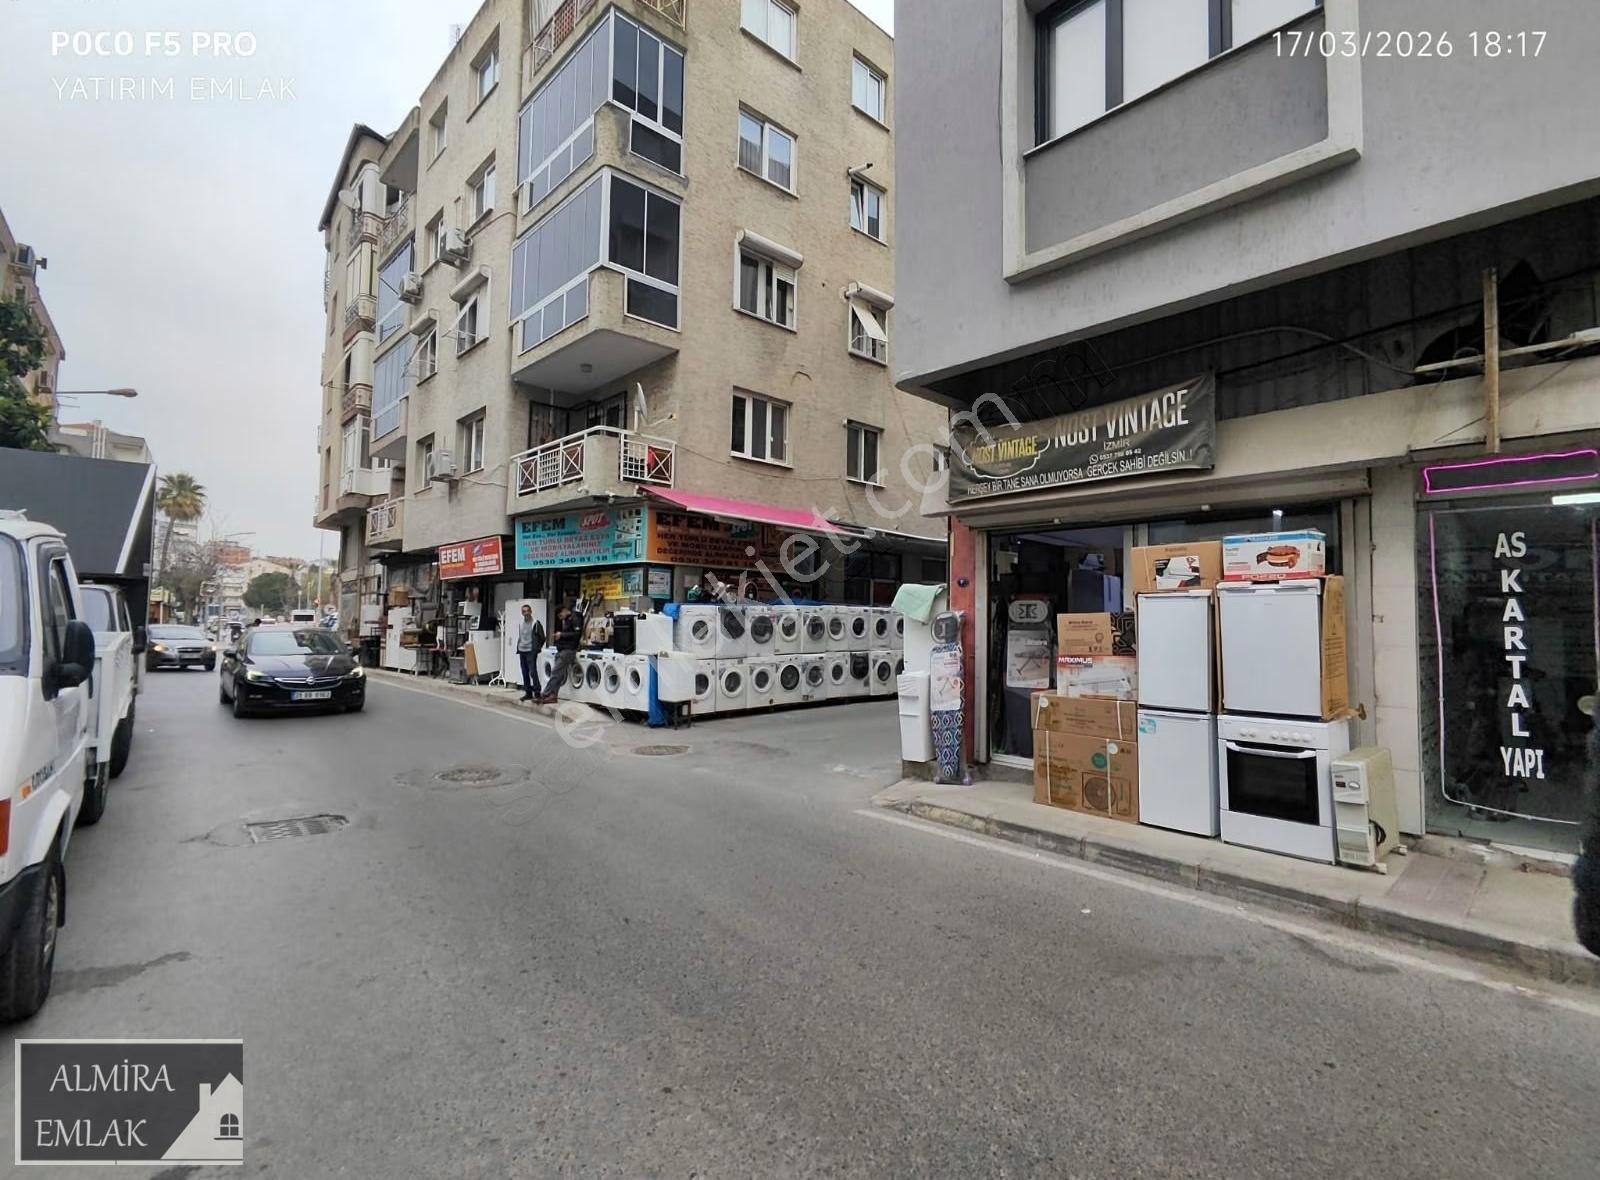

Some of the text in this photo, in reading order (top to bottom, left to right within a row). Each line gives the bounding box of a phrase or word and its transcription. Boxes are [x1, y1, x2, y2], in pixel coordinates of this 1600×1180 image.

[1055, 389, 1189, 448] NOST VINTAGE
[998, 436, 1038, 461] VINTAGE
[1003, 478, 1020, 490] TANE
[1021, 476, 1039, 488] SANA
[1039, 470, 1083, 485] OLMUYORSA
[521, 517, 566, 533] EFEM
[441, 548, 465, 564] EFEM
[1494, 531, 1527, 558] AS
[1058, 656, 1093, 664] MAXIMUS
[1500, 569, 1530, 737] KARTAL
[1500, 746, 1545, 779] YAPI
